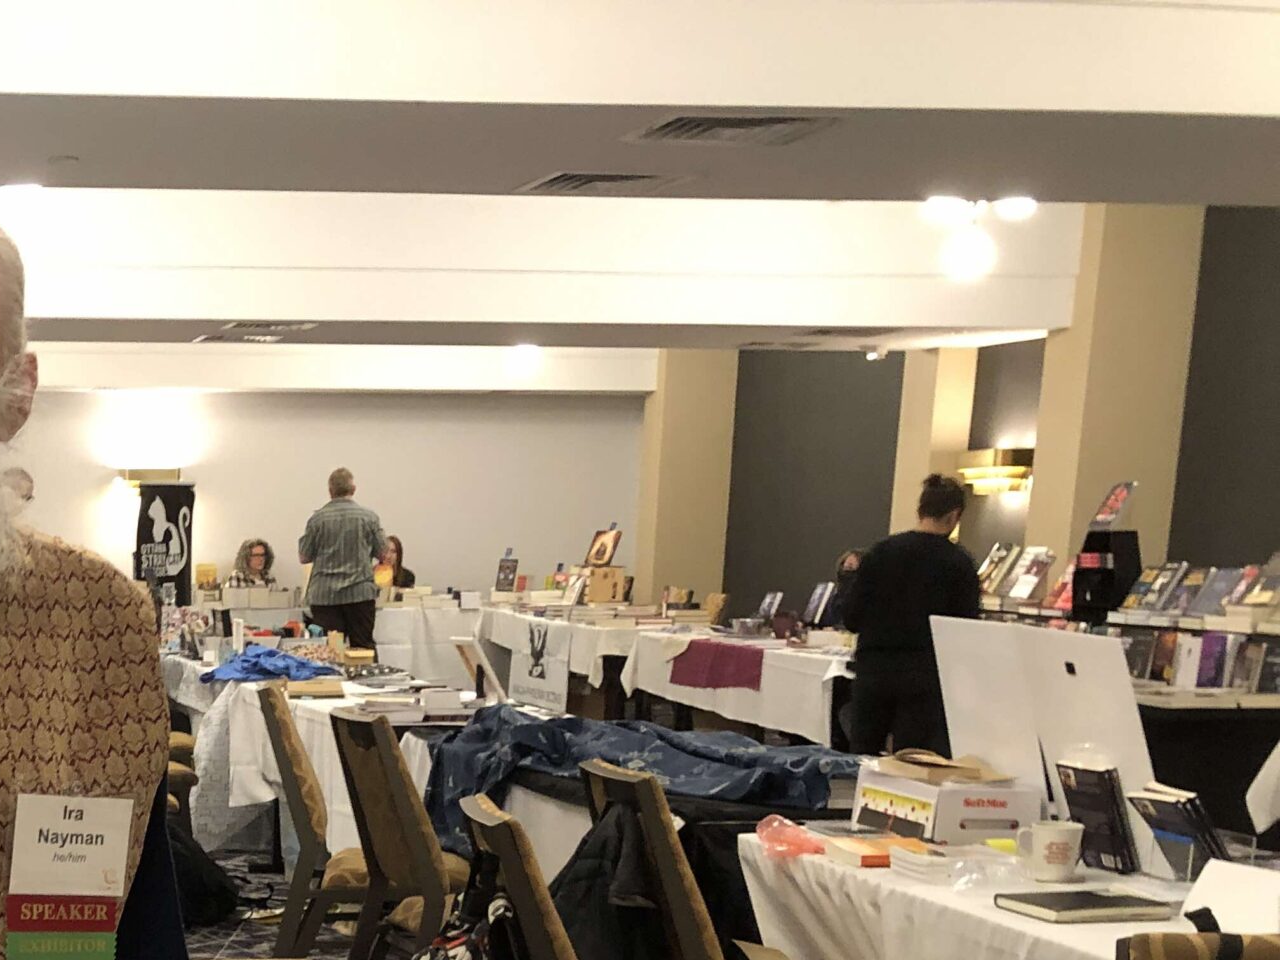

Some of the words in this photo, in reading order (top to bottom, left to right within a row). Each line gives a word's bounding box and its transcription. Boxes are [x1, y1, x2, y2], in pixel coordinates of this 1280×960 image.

[62, 805, 84, 821] Ira
[37, 828, 105, 848] Nayman
[51, 852, 87, 863] he/him
[20, 903, 109, 921] SPEAKER
